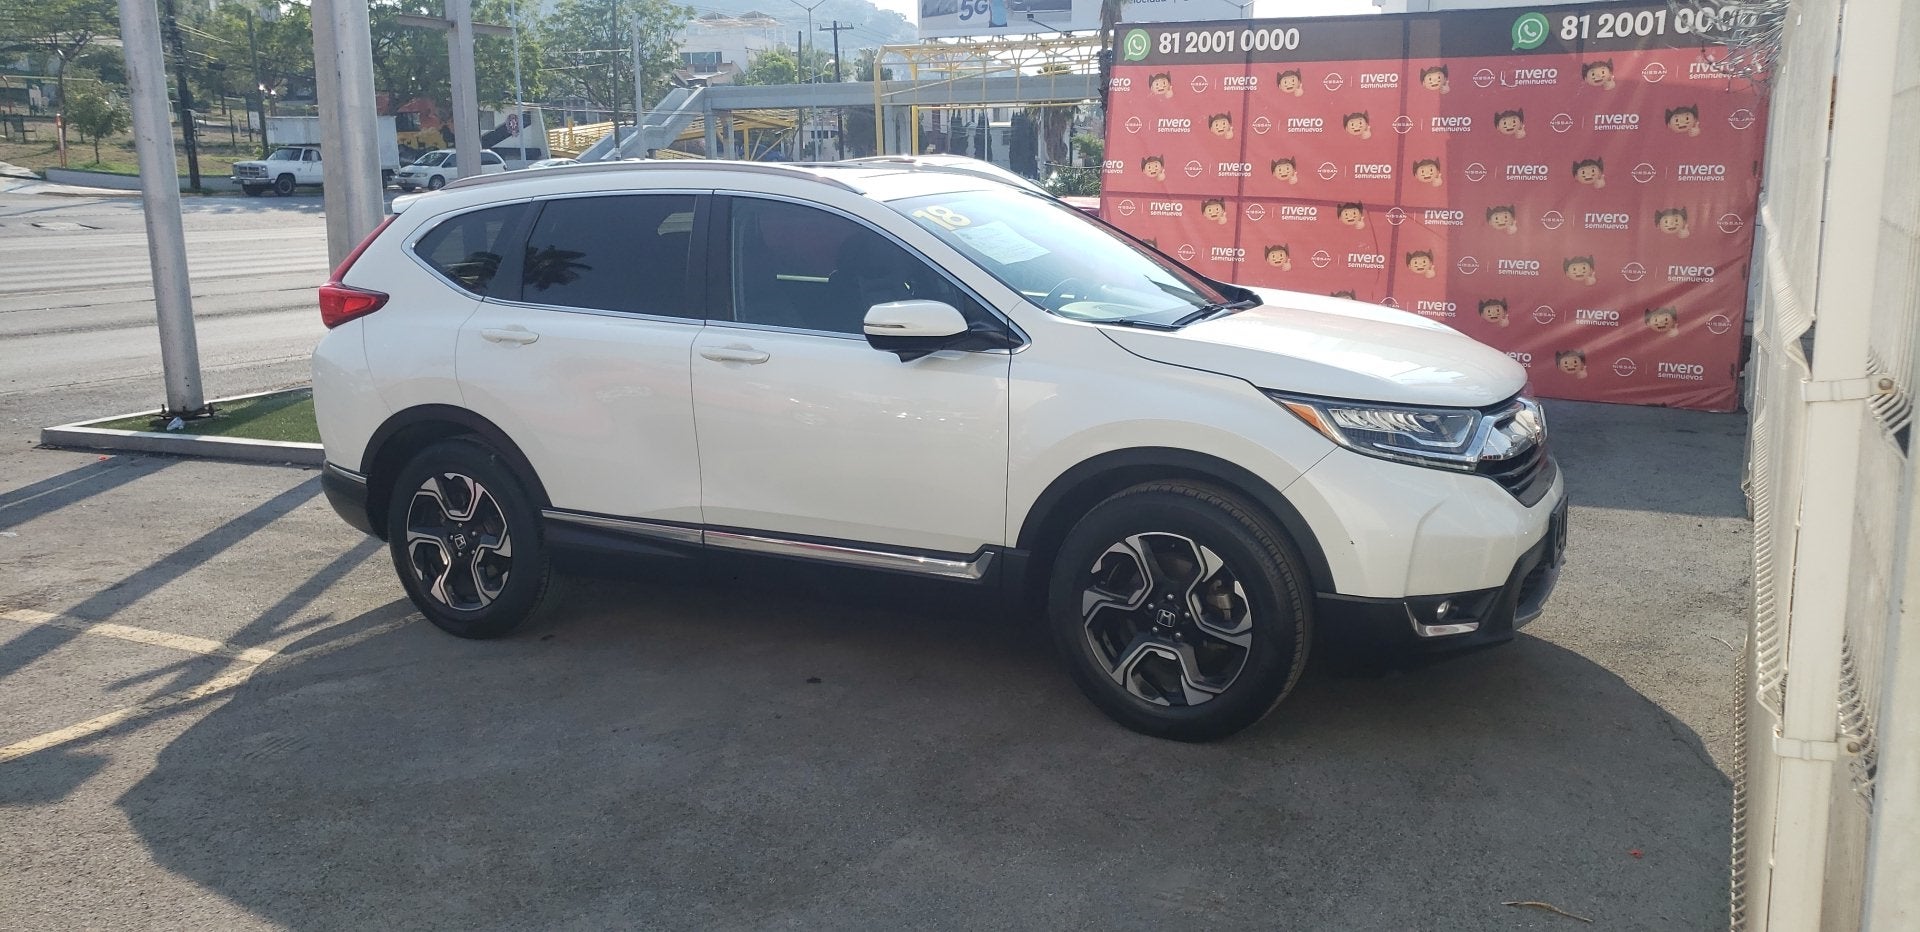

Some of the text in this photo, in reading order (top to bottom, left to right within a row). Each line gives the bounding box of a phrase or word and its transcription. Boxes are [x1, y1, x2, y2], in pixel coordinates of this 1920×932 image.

[960, 0, 988, 20] 5G
[1560, 15, 1590, 40] 81
[1596, 10, 1666, 38] 2001
[1159, 28, 1300, 54] 81 2001 0000
[1361, 73, 1398, 83] rivero
[1515, 69, 1557, 79] rivero
[1224, 76, 1257, 86] rivero
[1158, 118, 1190, 127] rivero
[1288, 117, 1323, 127] rivero
[1432, 116, 1471, 126] rivero
[1594, 113, 1639, 124] rivero
[1218, 162, 1251, 171] rivero
[1355, 164, 1391, 174] rivero
[1507, 164, 1548, 174] rivero
[1678, 164, 1725, 175] rivero
[1151, 202, 1182, 211] rivero
[1282, 206, 1317, 215] rivero
[912, 205, 971, 231] 18
[1425, 210, 1463, 220] rivero
[1585, 213, 1629, 223] rivero
[1212, 246, 1245, 256] rivero
[1348, 253, 1385, 263] rivero
[1499, 259, 1540, 270] rivero
[1668, 265, 1714, 276] rivero
[1418, 300, 1456, 311] rivero
[1576, 309, 1619, 320] rivero
[1658, 362, 1703, 374] rivero
[1658, 372, 1703, 381] seminuevos
